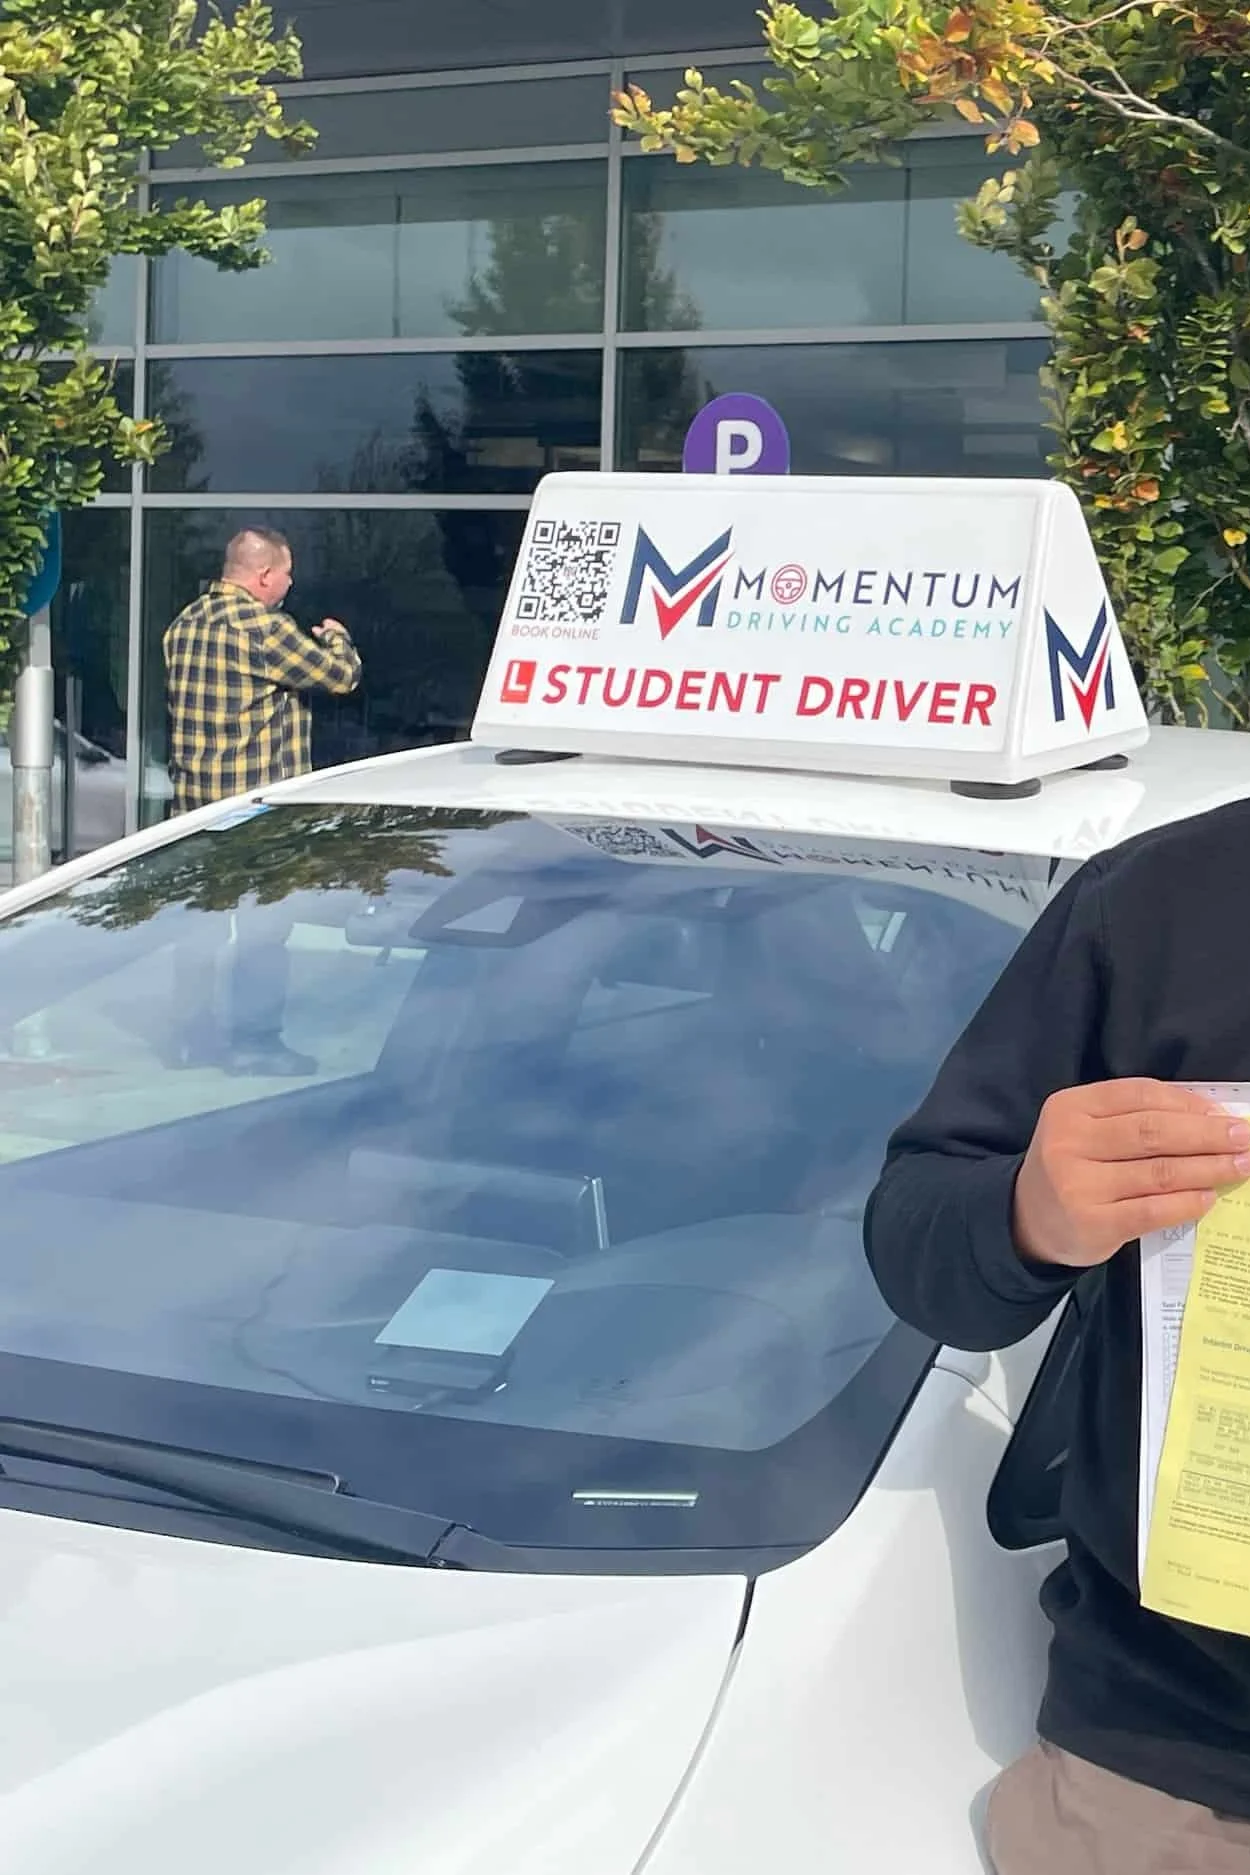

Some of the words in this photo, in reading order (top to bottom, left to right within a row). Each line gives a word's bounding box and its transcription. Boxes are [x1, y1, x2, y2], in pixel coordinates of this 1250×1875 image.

[715, 419, 763, 475] P
[734, 564, 1022, 609] MOMENTUM
[511, 626, 550, 639] BOOK
[552, 628, 600, 640] ONLINE
[727, 611, 852, 635] DRIVING
[866, 618, 1014, 640] ACADEMY
[542, 664, 781, 714] STUDENT
[796, 675, 997, 727] DRIVER
